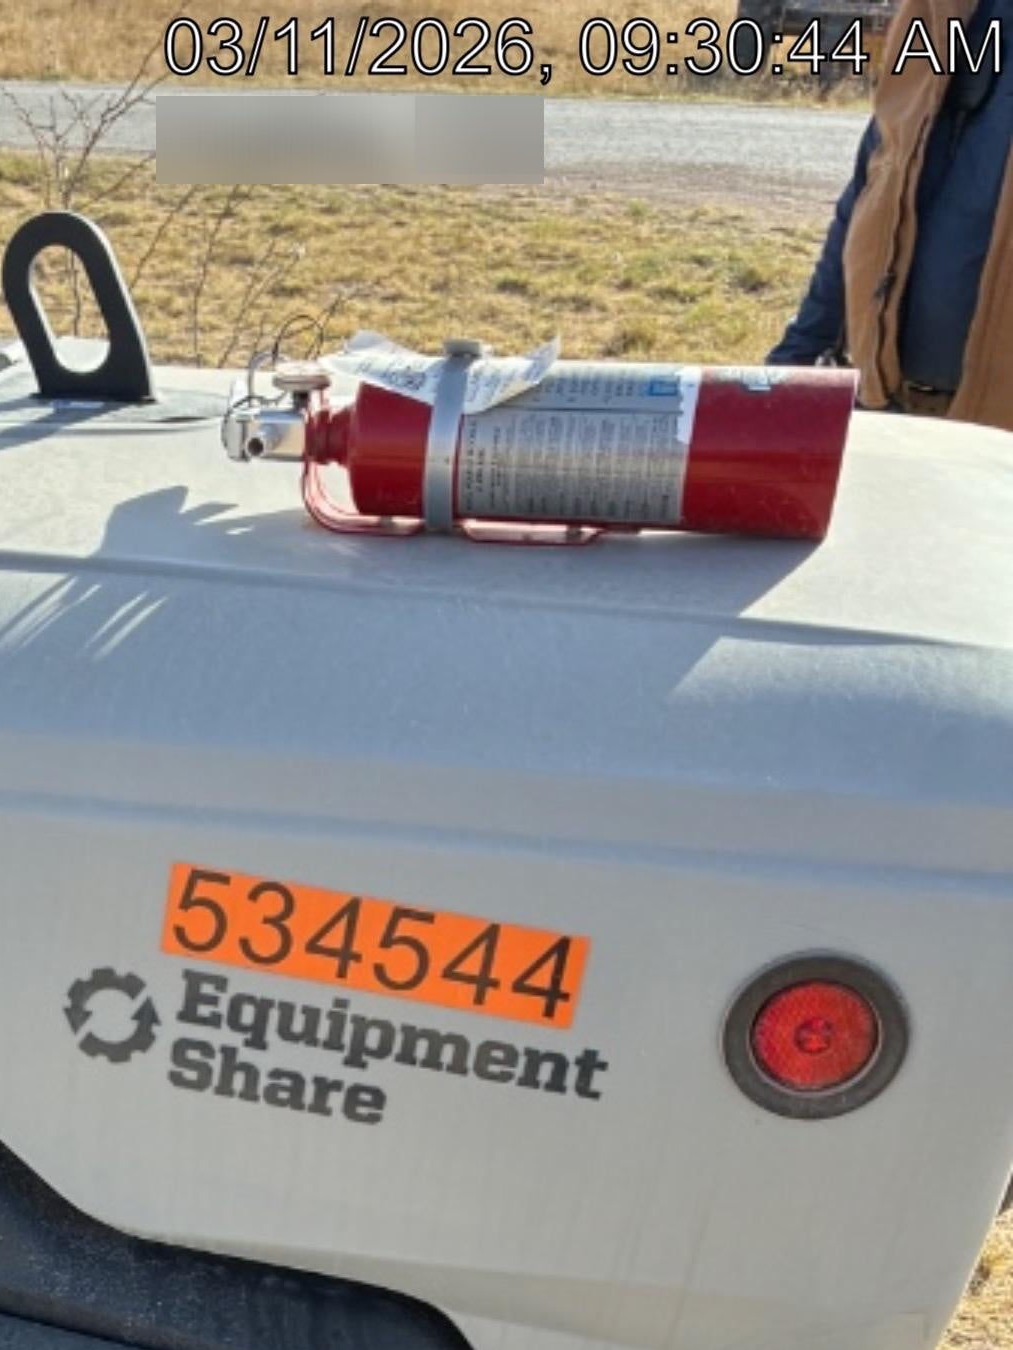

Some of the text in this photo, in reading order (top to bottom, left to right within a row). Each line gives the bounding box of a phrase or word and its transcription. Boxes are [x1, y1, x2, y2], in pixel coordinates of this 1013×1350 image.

[172, 867, 571, 1018] 534544
[168, 1039, 386, 1125] Share
[176, 969, 608, 1100] Equipment
